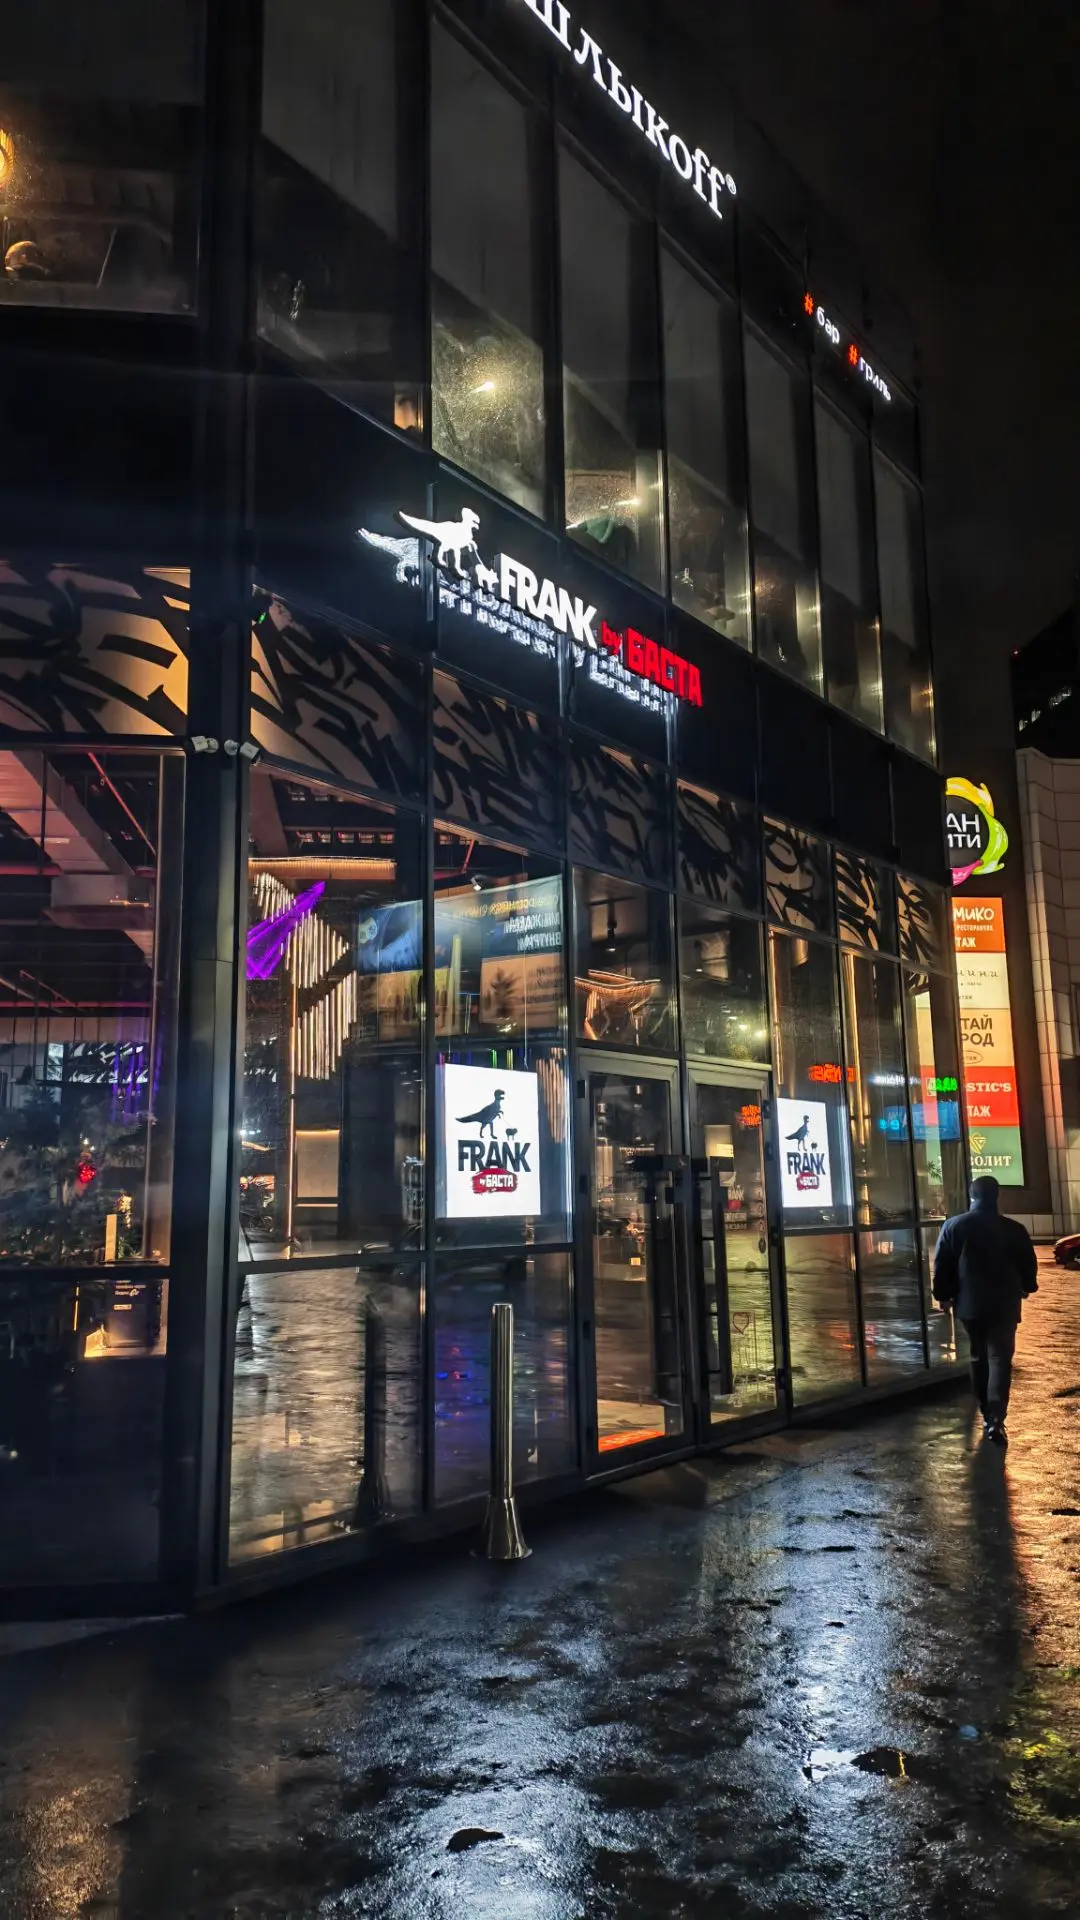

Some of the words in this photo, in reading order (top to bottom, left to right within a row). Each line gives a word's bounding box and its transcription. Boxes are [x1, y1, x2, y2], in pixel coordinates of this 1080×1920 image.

[500, 552, 598, 650] FRANK
[602, 620, 623, 656] by
[625, 626, 703, 708] БАСТА
[946, 813, 980, 833] АН
[458, 1140, 531, 1172] FRANK
[787, 1152, 826, 1175] FRANK
[486, 1175, 514, 1188] БАСТА
